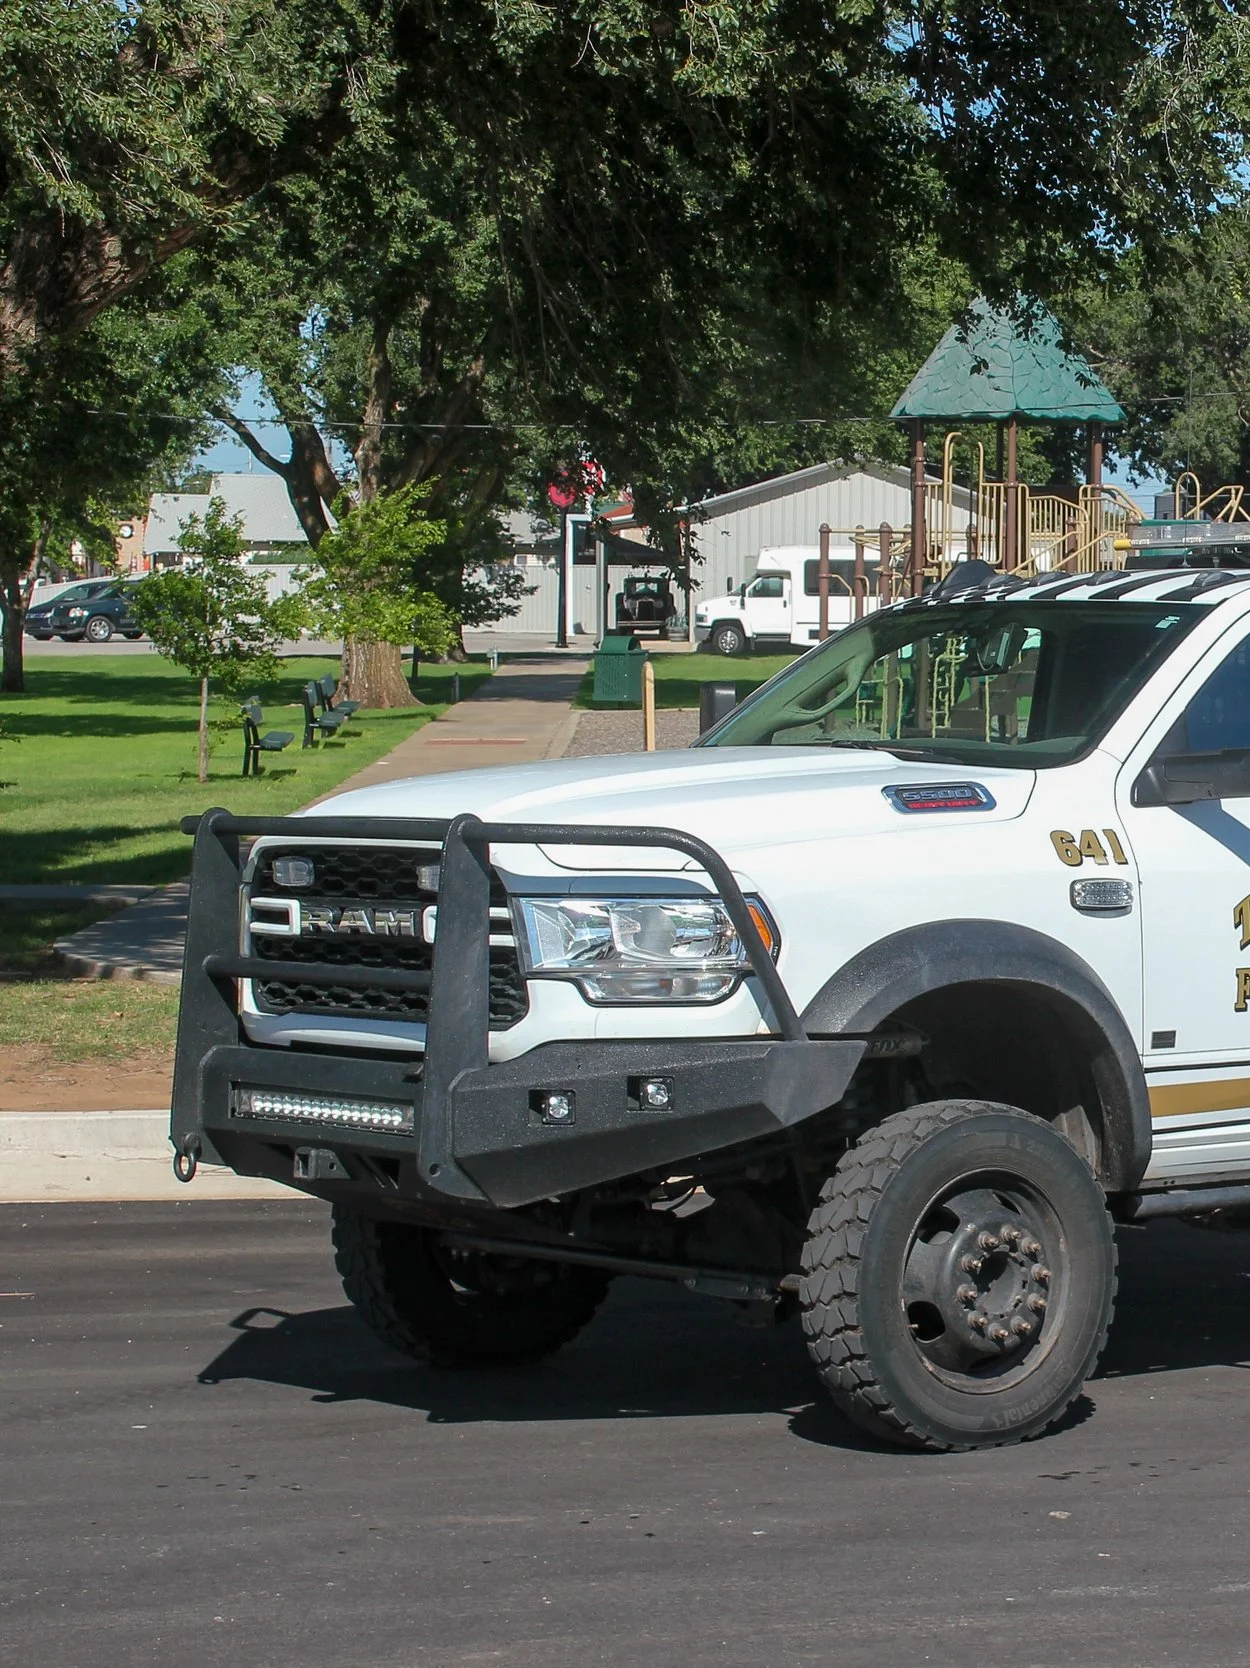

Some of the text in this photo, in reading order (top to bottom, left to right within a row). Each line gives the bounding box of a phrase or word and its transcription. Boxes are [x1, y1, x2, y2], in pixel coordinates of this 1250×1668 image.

[903, 789, 972, 801] 5500
[1050, 828, 1129, 867] 641
[301, 906, 416, 937] RAM
